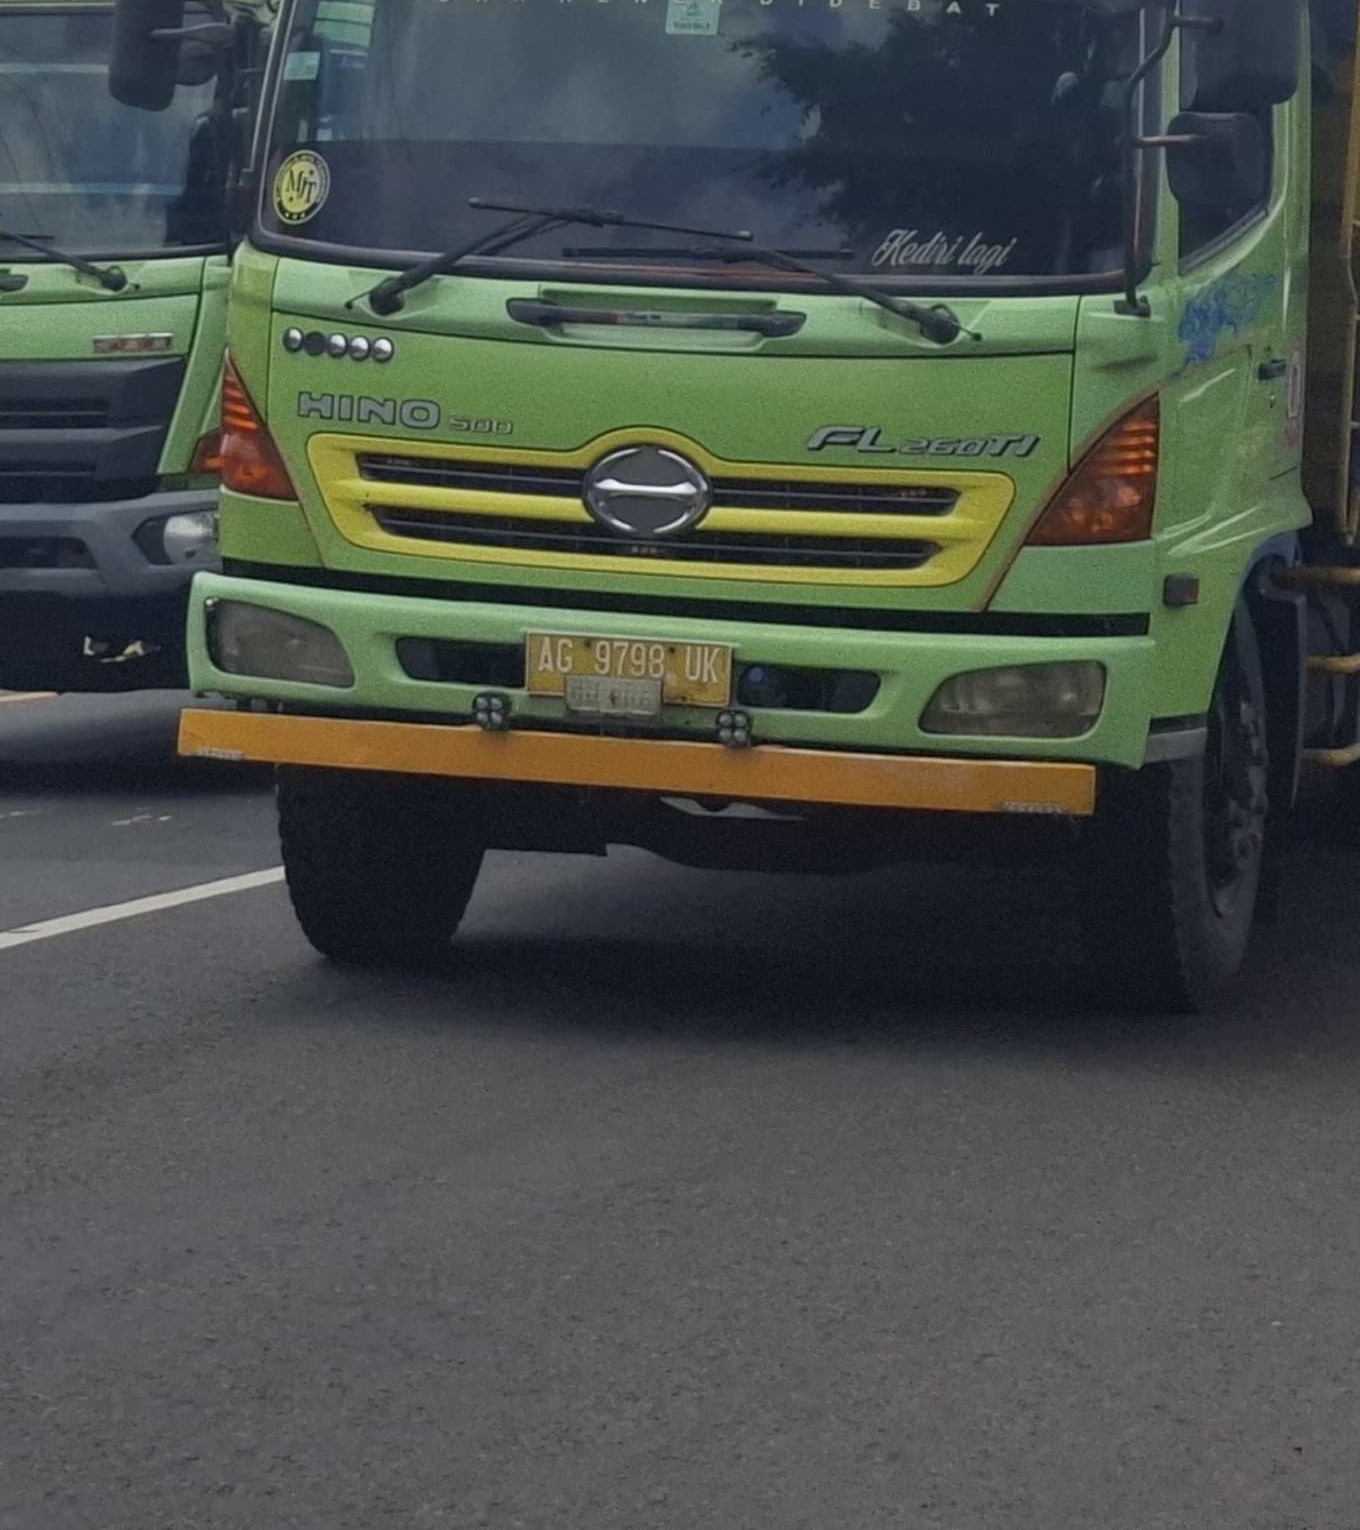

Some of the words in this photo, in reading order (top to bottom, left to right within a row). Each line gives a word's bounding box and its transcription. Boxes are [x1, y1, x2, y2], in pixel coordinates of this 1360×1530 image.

[871, 229, 964, 267] Kediri
[957, 231, 1018, 276] lagi
[298, 391, 440, 430] HINO
[449, 416, 513, 435] 500
[539, 637, 573, 673] AG
[594, 641, 665, 678] 9798
[685, 646, 720, 683] UK
